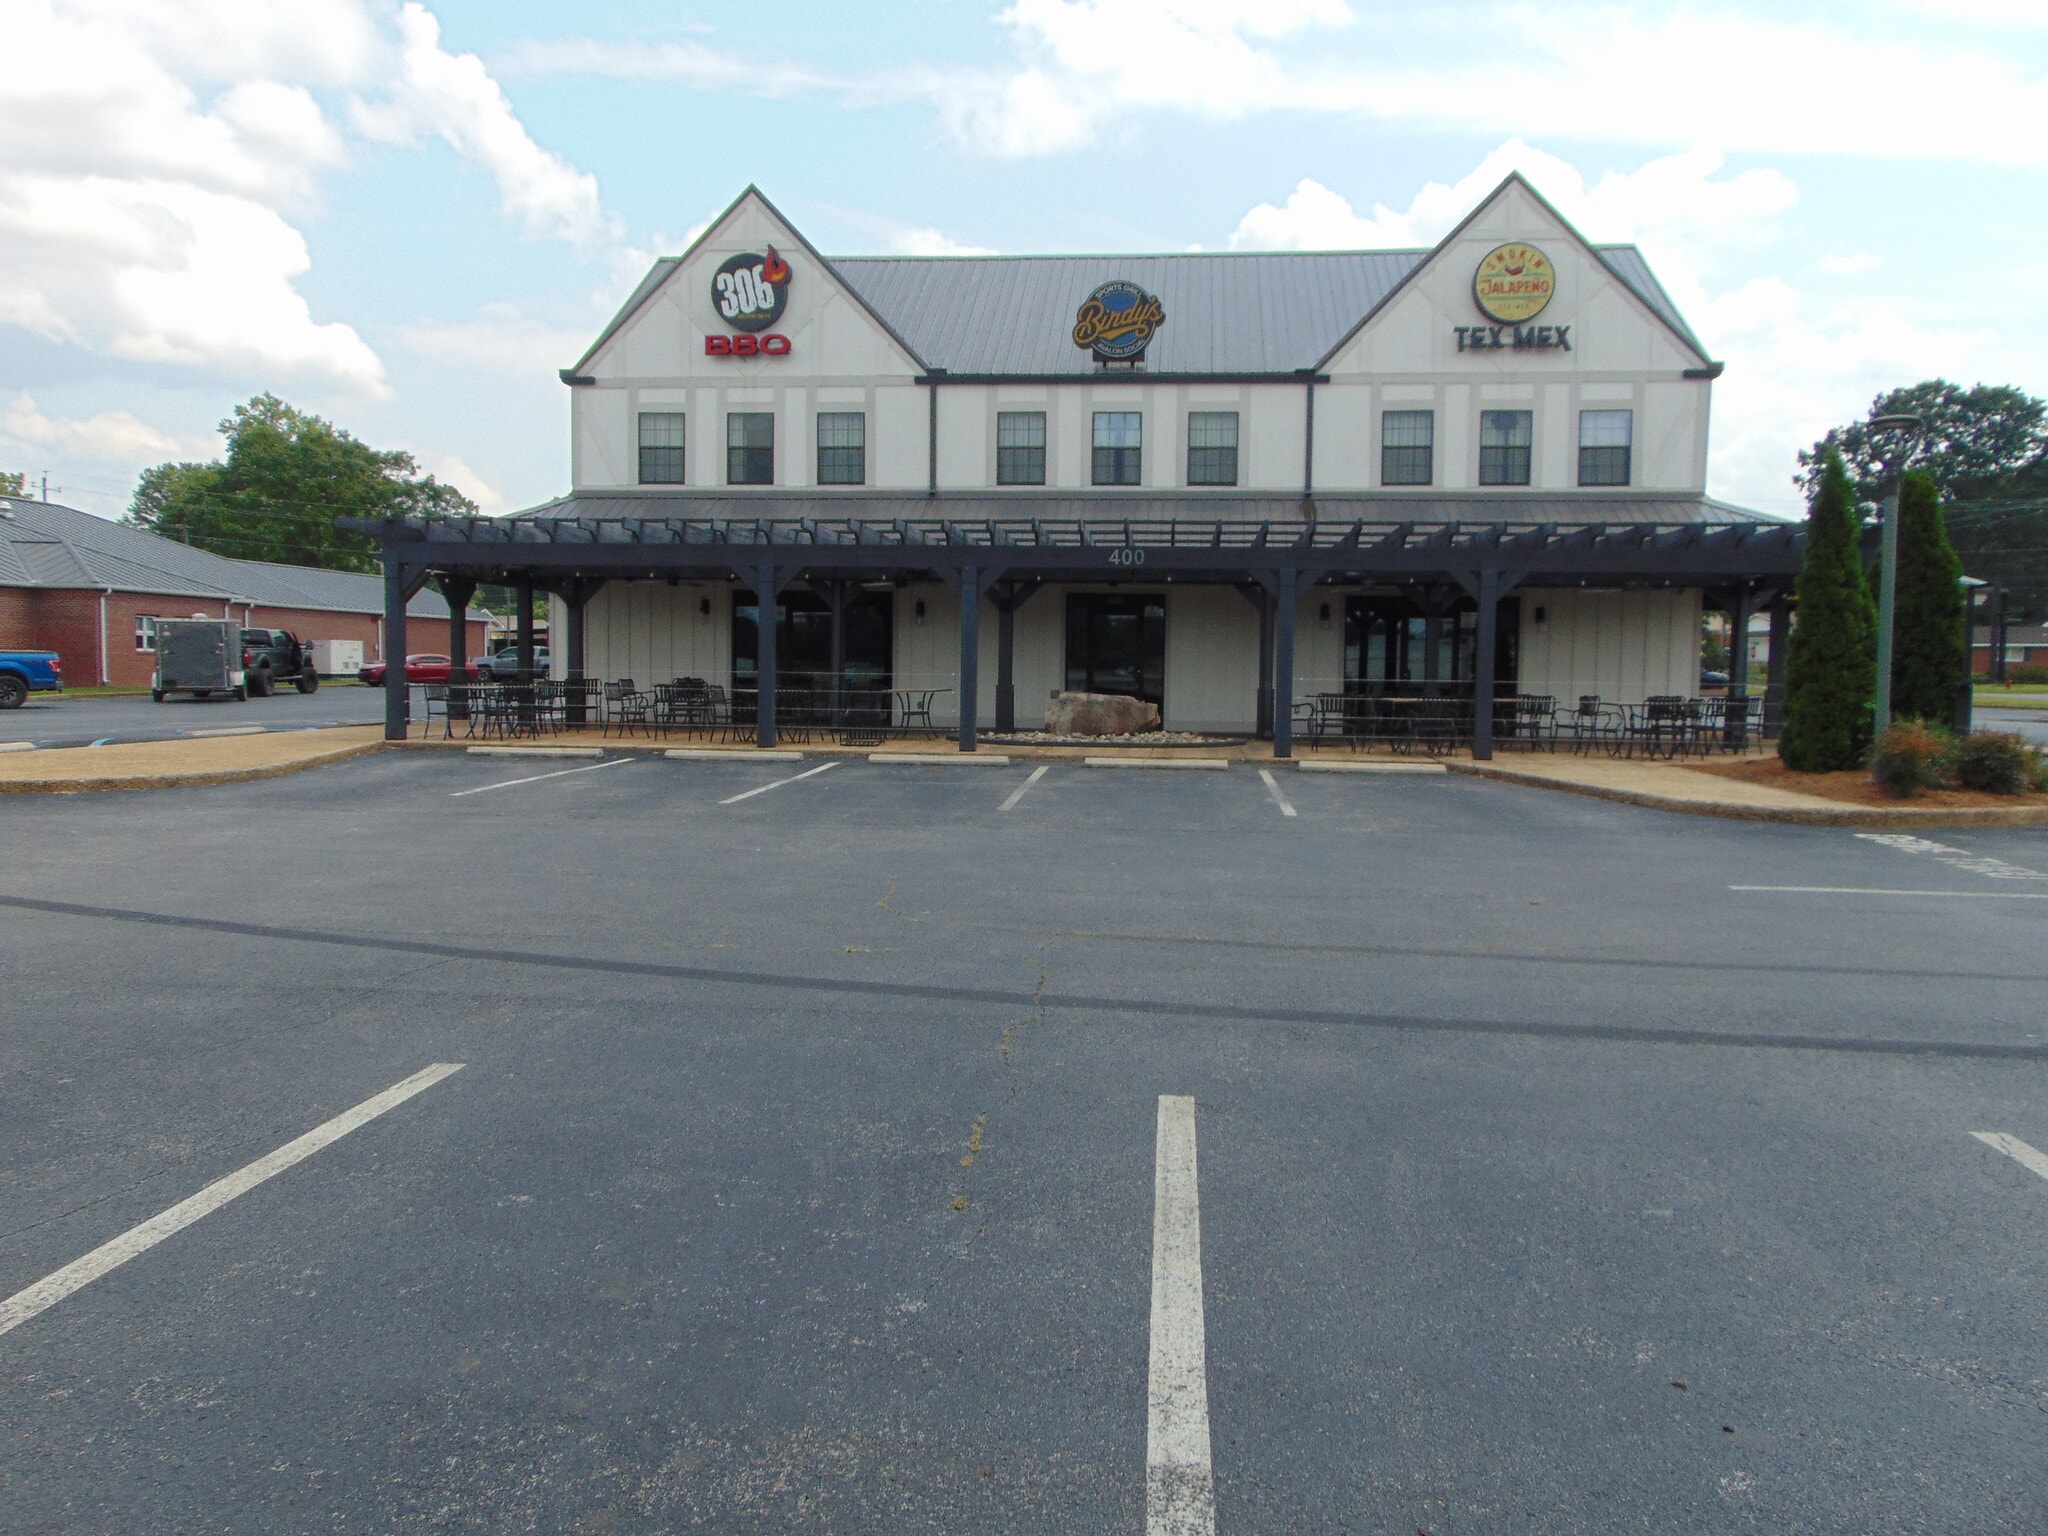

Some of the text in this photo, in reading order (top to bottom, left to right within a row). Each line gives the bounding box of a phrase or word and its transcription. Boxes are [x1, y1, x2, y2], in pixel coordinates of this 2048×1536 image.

[1486, 249, 1544, 270] SMOKIN
[717, 264, 775, 317] 306
[1095, 284, 1122, 298] SPORTS
[705, 334, 791, 355] BBQ
[1453, 325, 1572, 352] TEX MEX
[1108, 549, 1145, 565] 400
